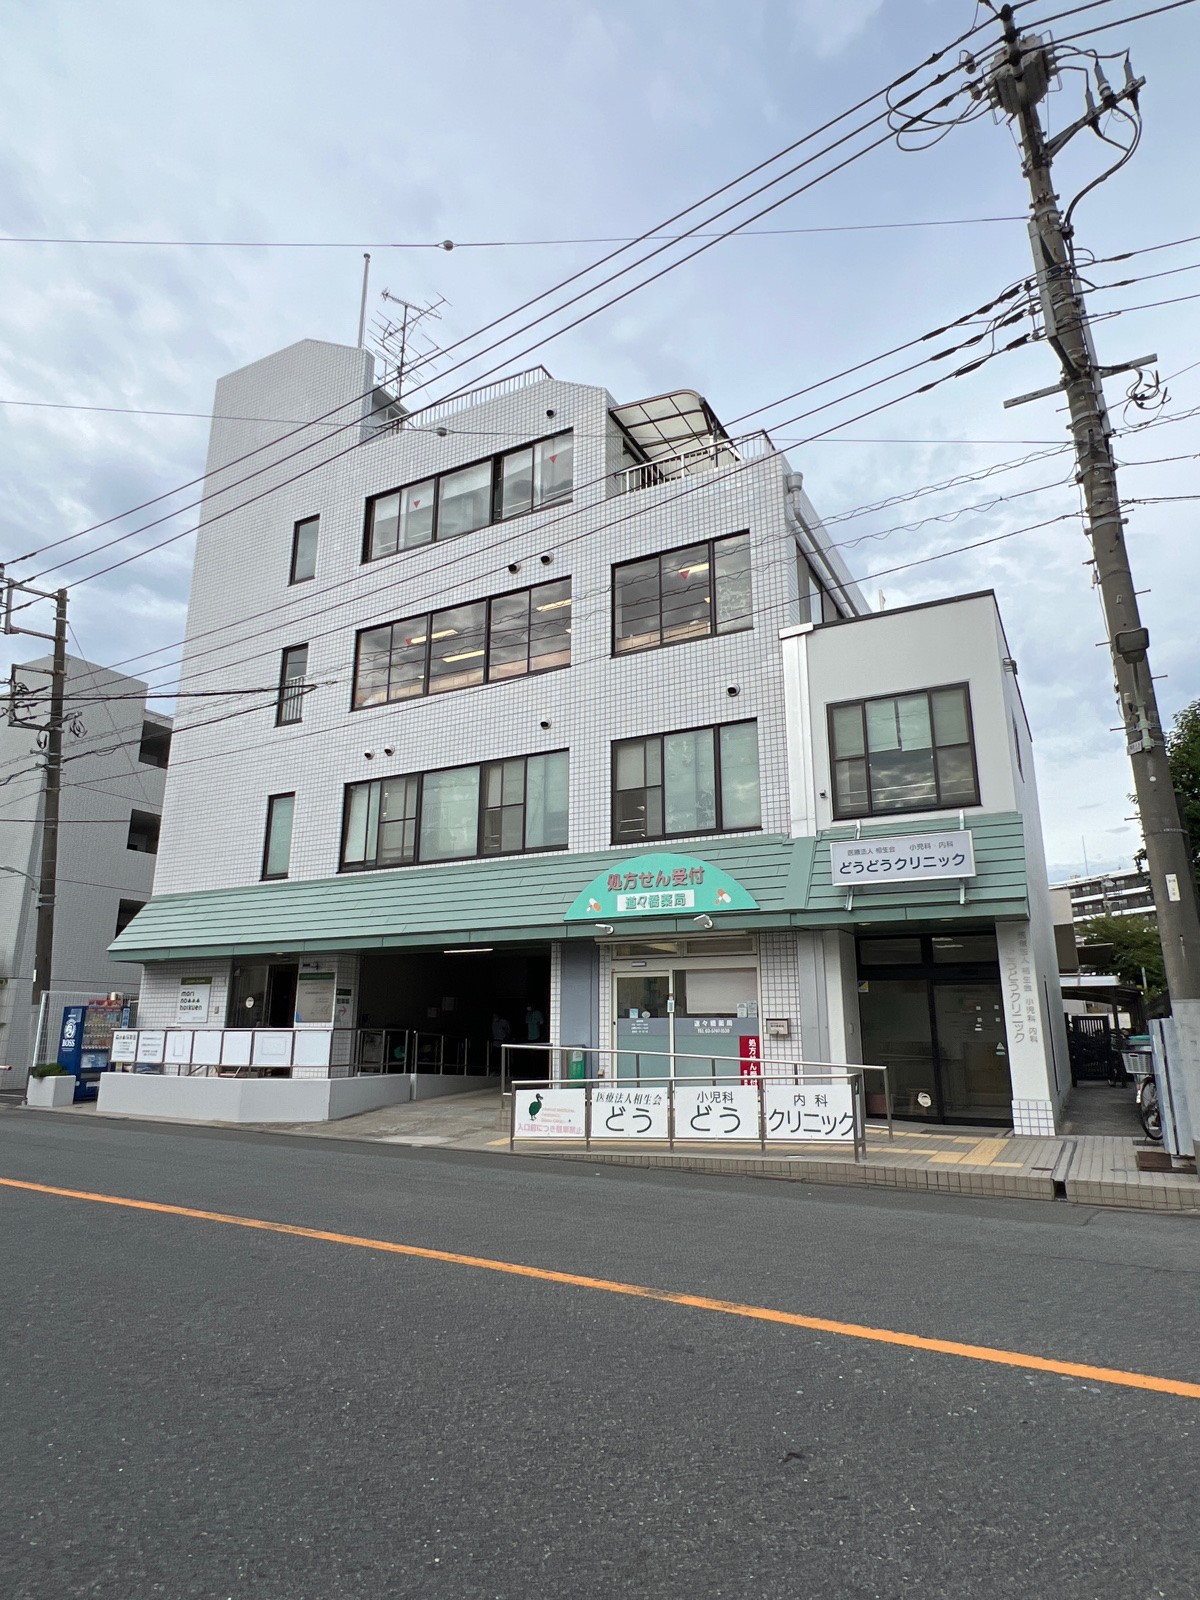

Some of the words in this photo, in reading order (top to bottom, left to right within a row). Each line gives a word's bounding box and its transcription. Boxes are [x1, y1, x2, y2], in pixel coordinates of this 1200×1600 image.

[840, 852, 965, 875] どうどうクリニック
[607, 866, 705, 892] 処方せん受付
[625, 893, 687, 910] 道々橋薬局
[1025, 998, 1036, 1023] 小児科
[61, 1038, 76, 1047] BOSS
[1029, 1027, 1038, 1043] 内科
[596, 1091, 663, 1106] 医療法人相生会
[696, 1090, 735, 1105] 小児科
[605, 1105, 653, 1134] どう
[690, 1104, 741, 1134] どう
[768, 1108, 855, 1137] クリニック
